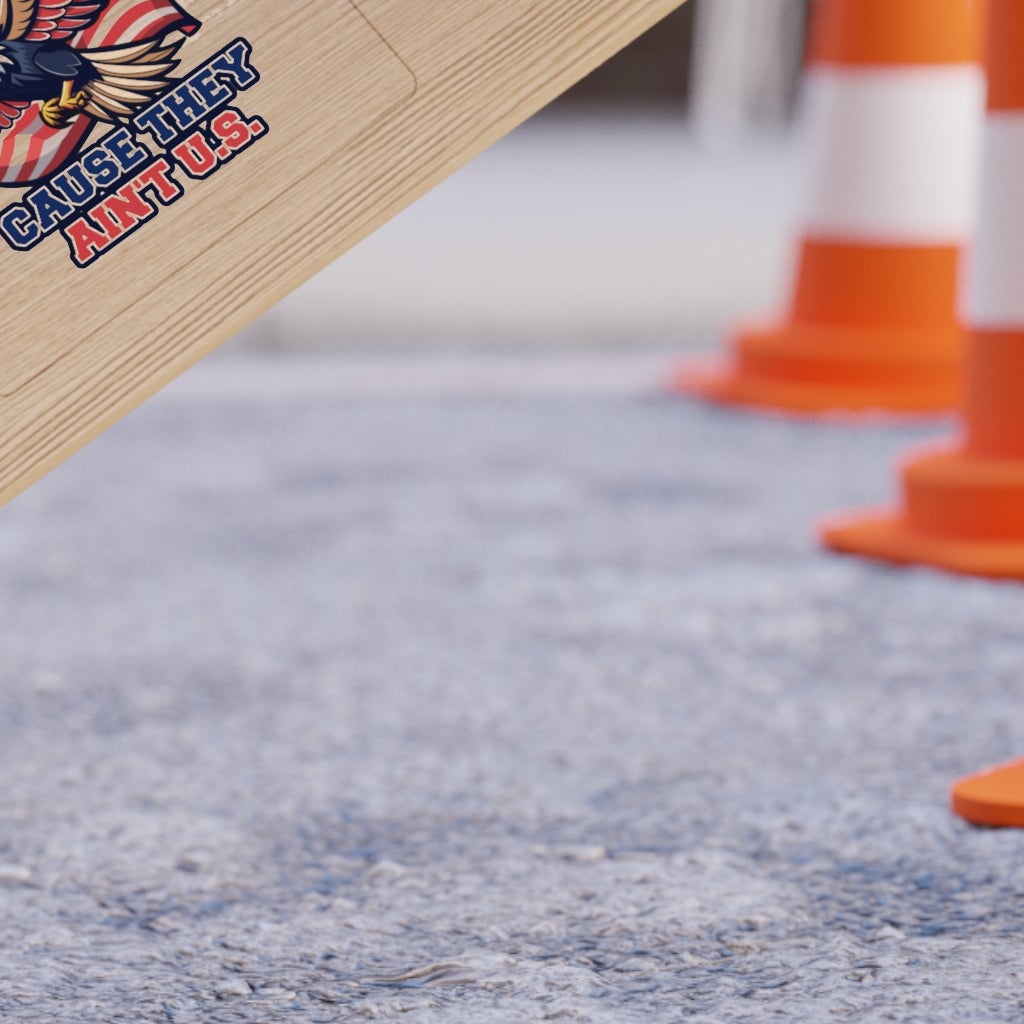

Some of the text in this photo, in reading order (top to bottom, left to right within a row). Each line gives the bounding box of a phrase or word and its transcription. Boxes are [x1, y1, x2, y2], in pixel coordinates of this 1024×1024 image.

[0, 40, 258, 246] CAUSE THEY
[65, 108, 264, 263] AIN'T U.S.
